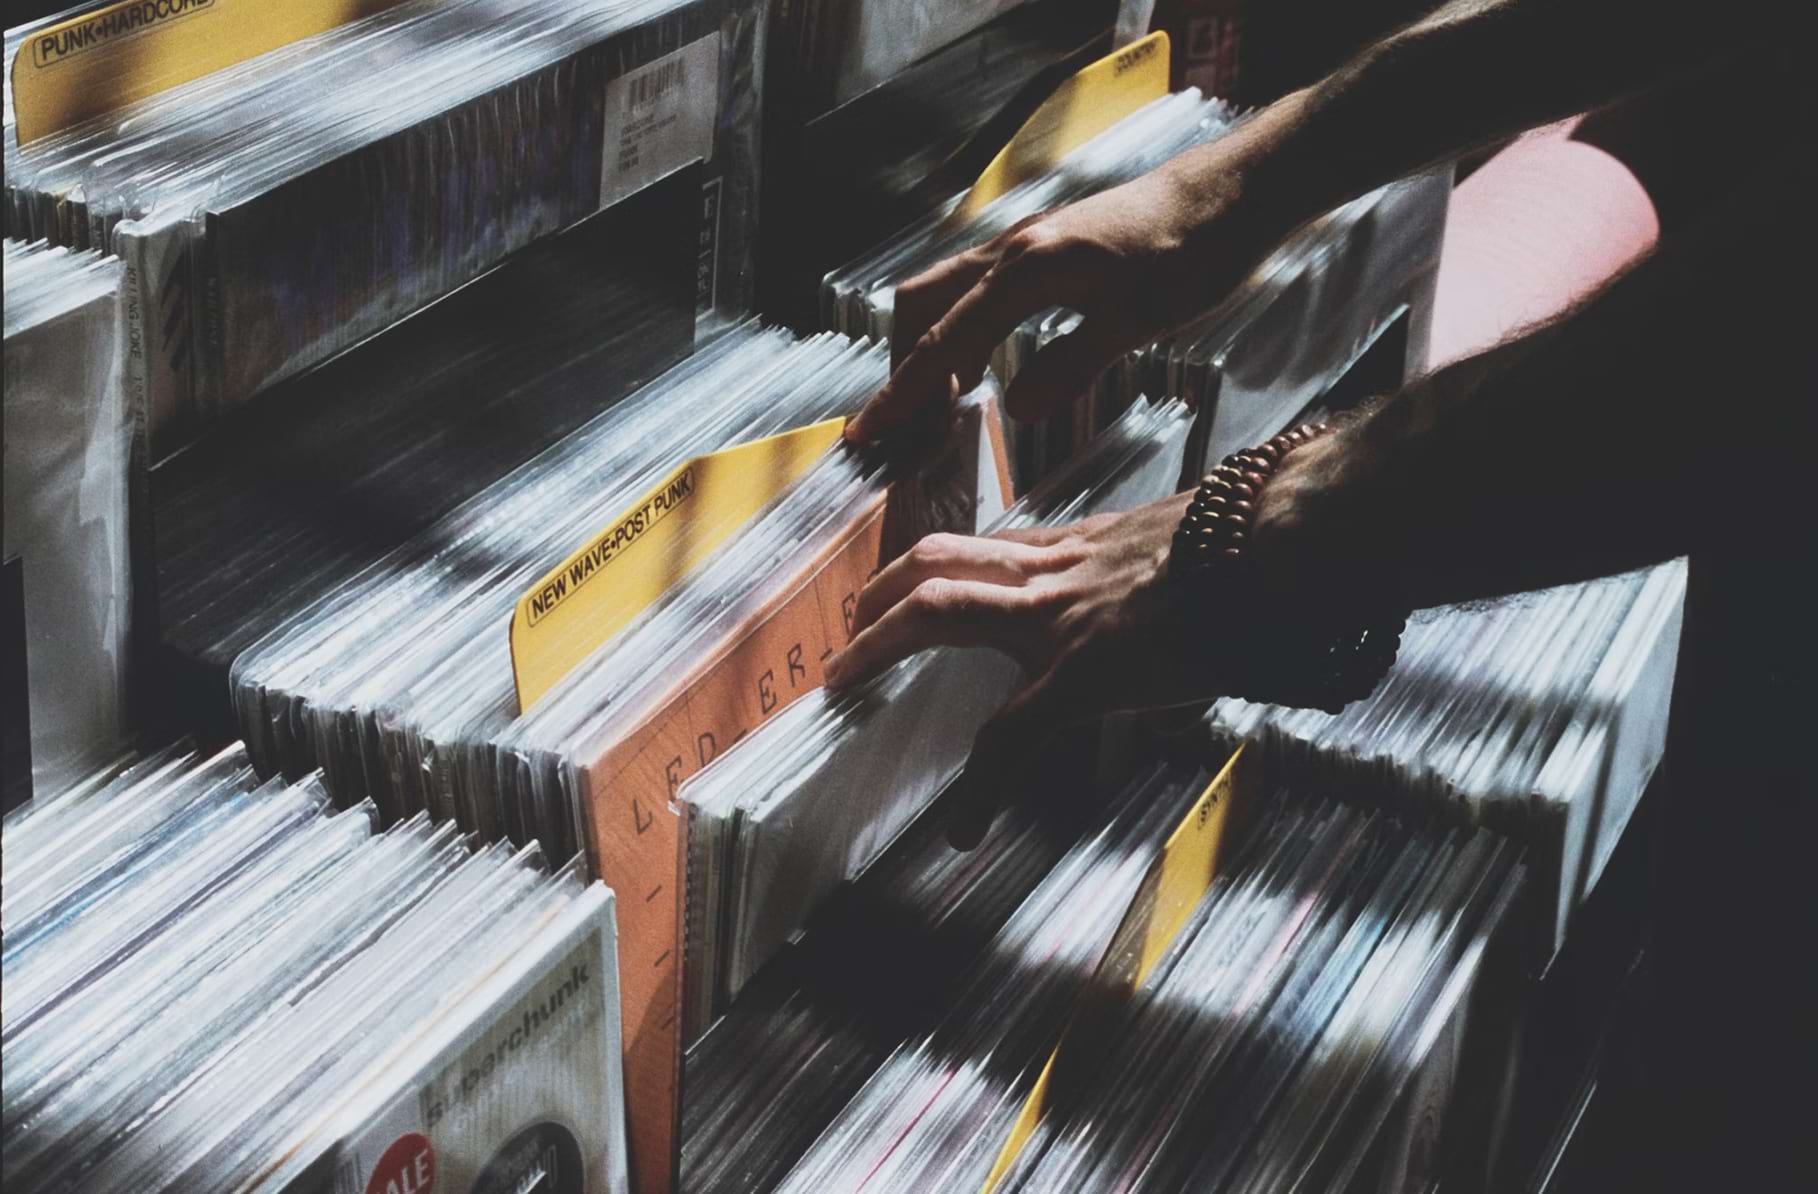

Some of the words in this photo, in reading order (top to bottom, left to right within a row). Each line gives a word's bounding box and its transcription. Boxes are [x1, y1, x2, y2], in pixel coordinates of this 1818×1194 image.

[532, 574, 567, 618] NEW
[654, 473, 691, 517] PUNK
[376, 1148, 430, 1194] ALE
